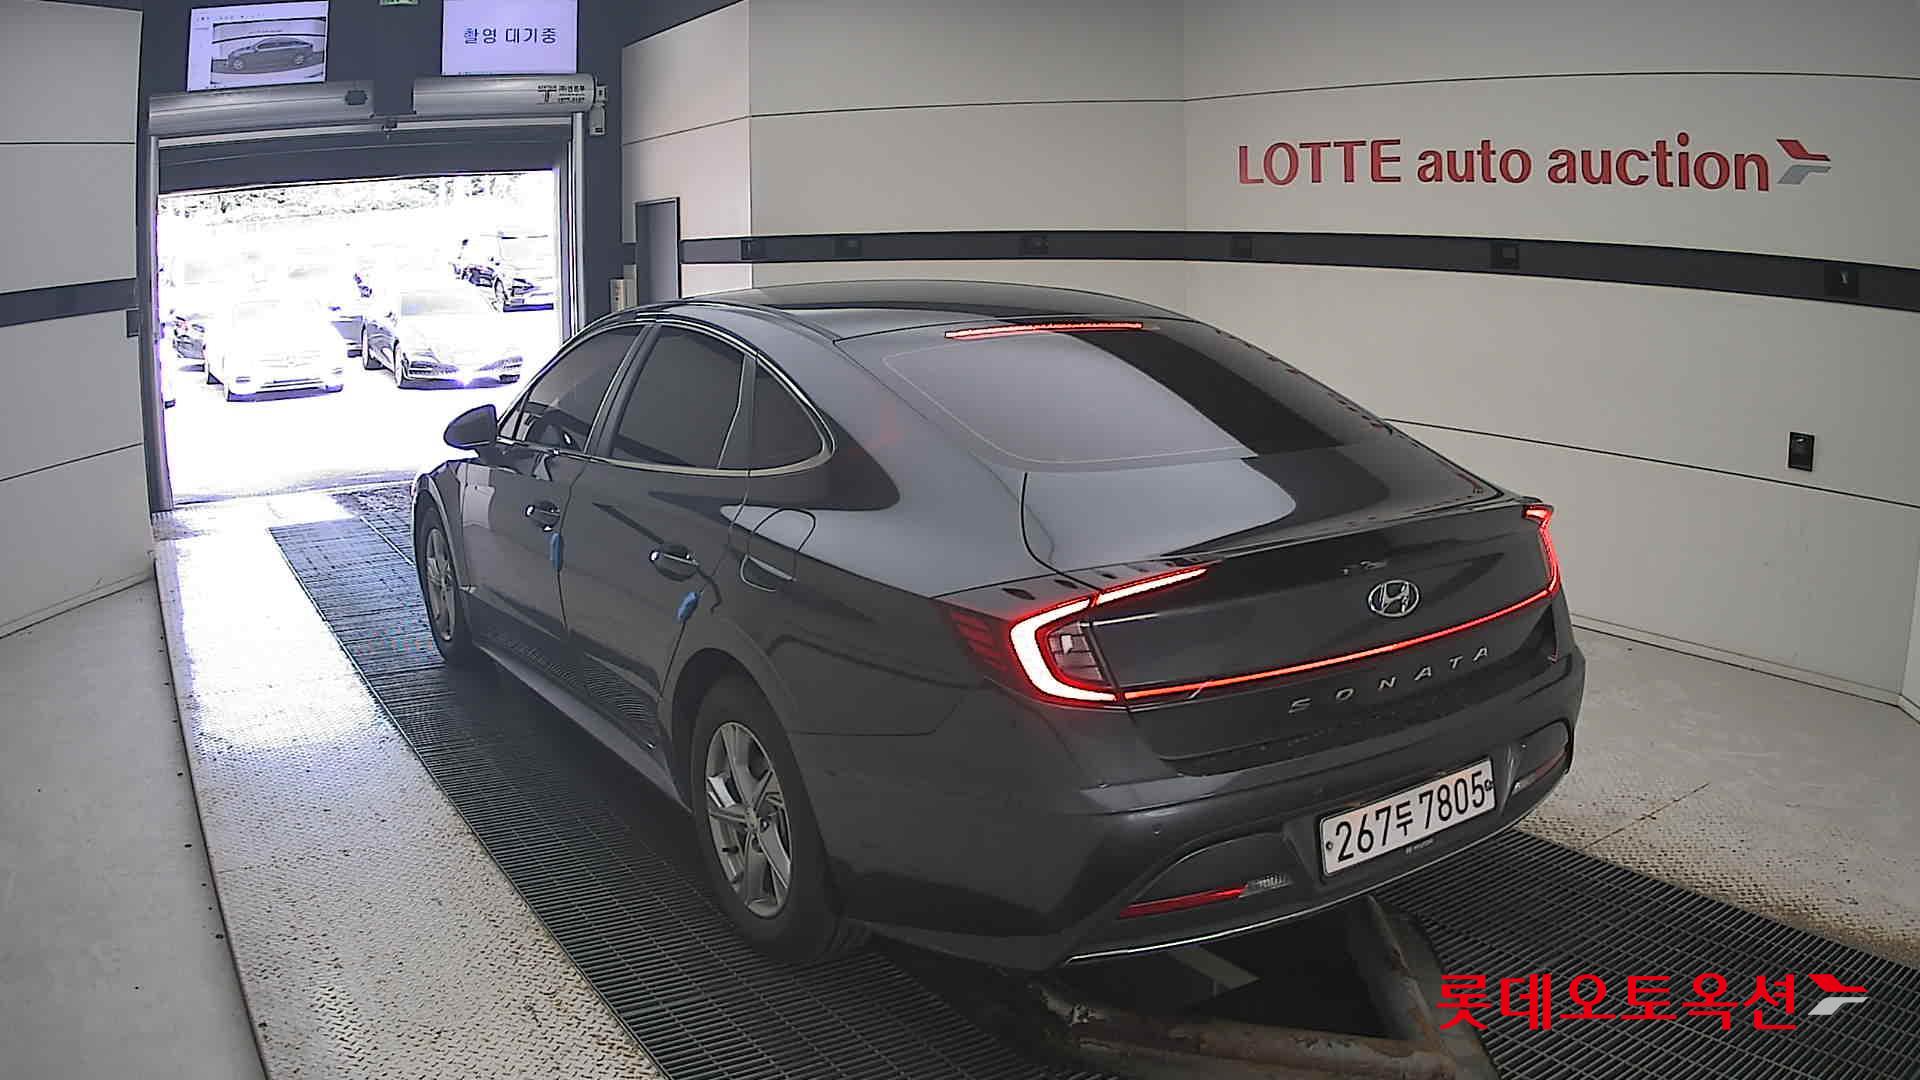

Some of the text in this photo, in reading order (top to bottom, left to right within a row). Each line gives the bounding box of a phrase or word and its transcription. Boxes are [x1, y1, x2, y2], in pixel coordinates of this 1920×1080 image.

[505, 27, 557, 45] 대기중
[1238, 132, 1771, 193] LOTTE auto auction
[1287, 646, 1489, 714] SONATA
